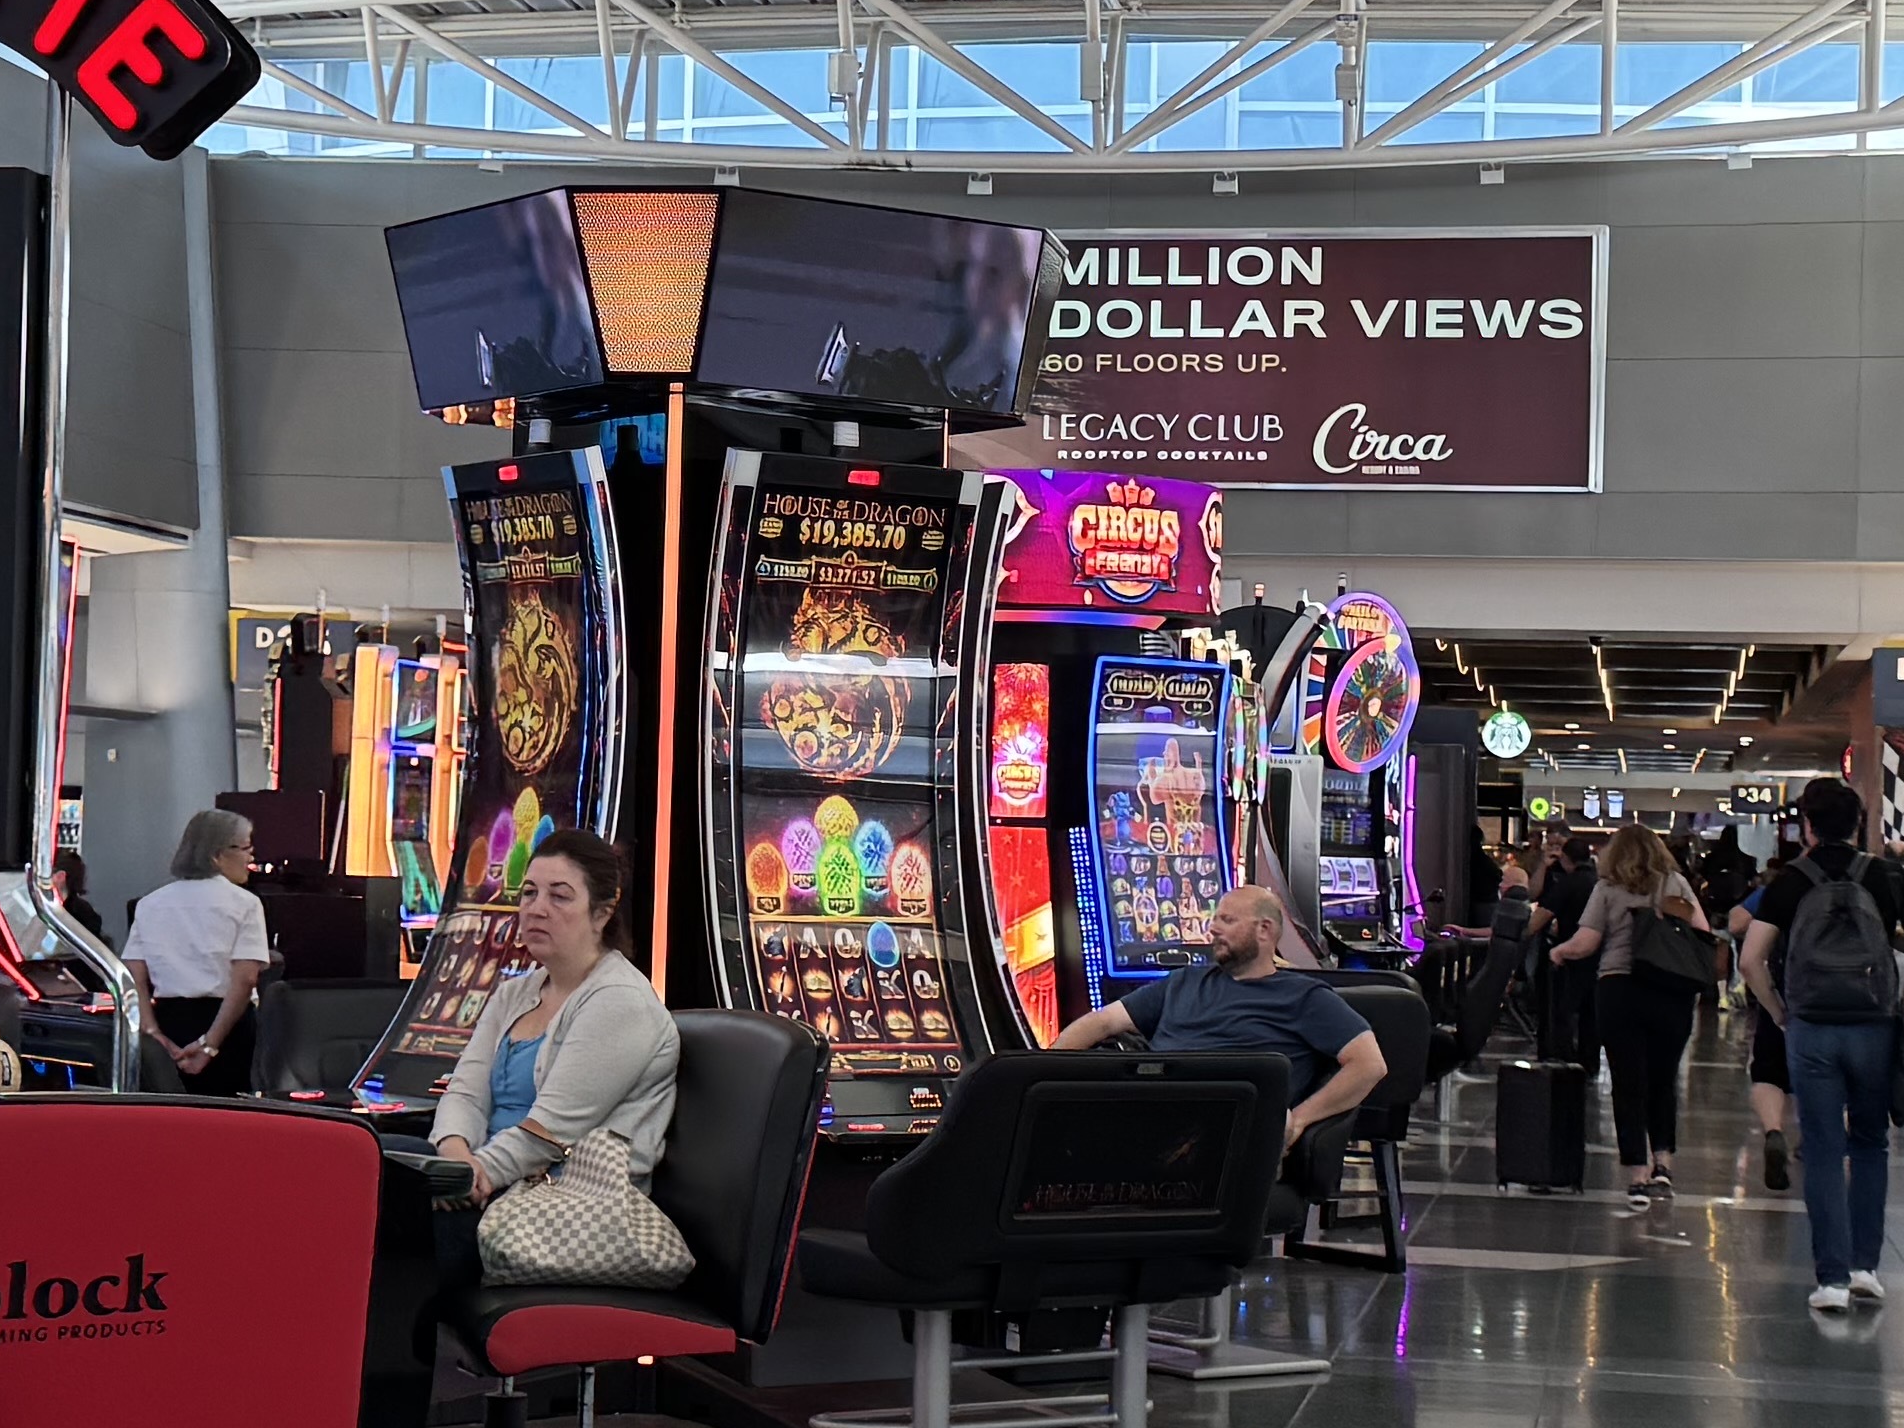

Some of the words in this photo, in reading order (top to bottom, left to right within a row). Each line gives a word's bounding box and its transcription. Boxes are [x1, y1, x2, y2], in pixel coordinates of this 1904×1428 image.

[1061, 245, 1323, 287] MILLION
[1048, 298, 1328, 339] DOLLAR
[1349, 297, 1585, 340] VIEWS
[1043, 353, 1084, 373] 60
[1095, 353, 1225, 373] FLOORS
[1237, 353, 1288, 373] UP.
[1042, 413, 1180, 442] LEGACY
[1187, 413, 1285, 442] CLUB
[1312, 402, 1453, 474] Circa
[1057, 450, 1149, 461] ROOFTOP
[1156, 450, 1268, 462] COCKTAILS
[763, 493, 832, 519] HOUSE
[853, 500, 946, 528] DRAGON
[799, 516, 906, 551] $19,385.70
[1071, 504, 1180, 559] CIRCUS
[57, 1319, 167, 1340] PRODUCTS
